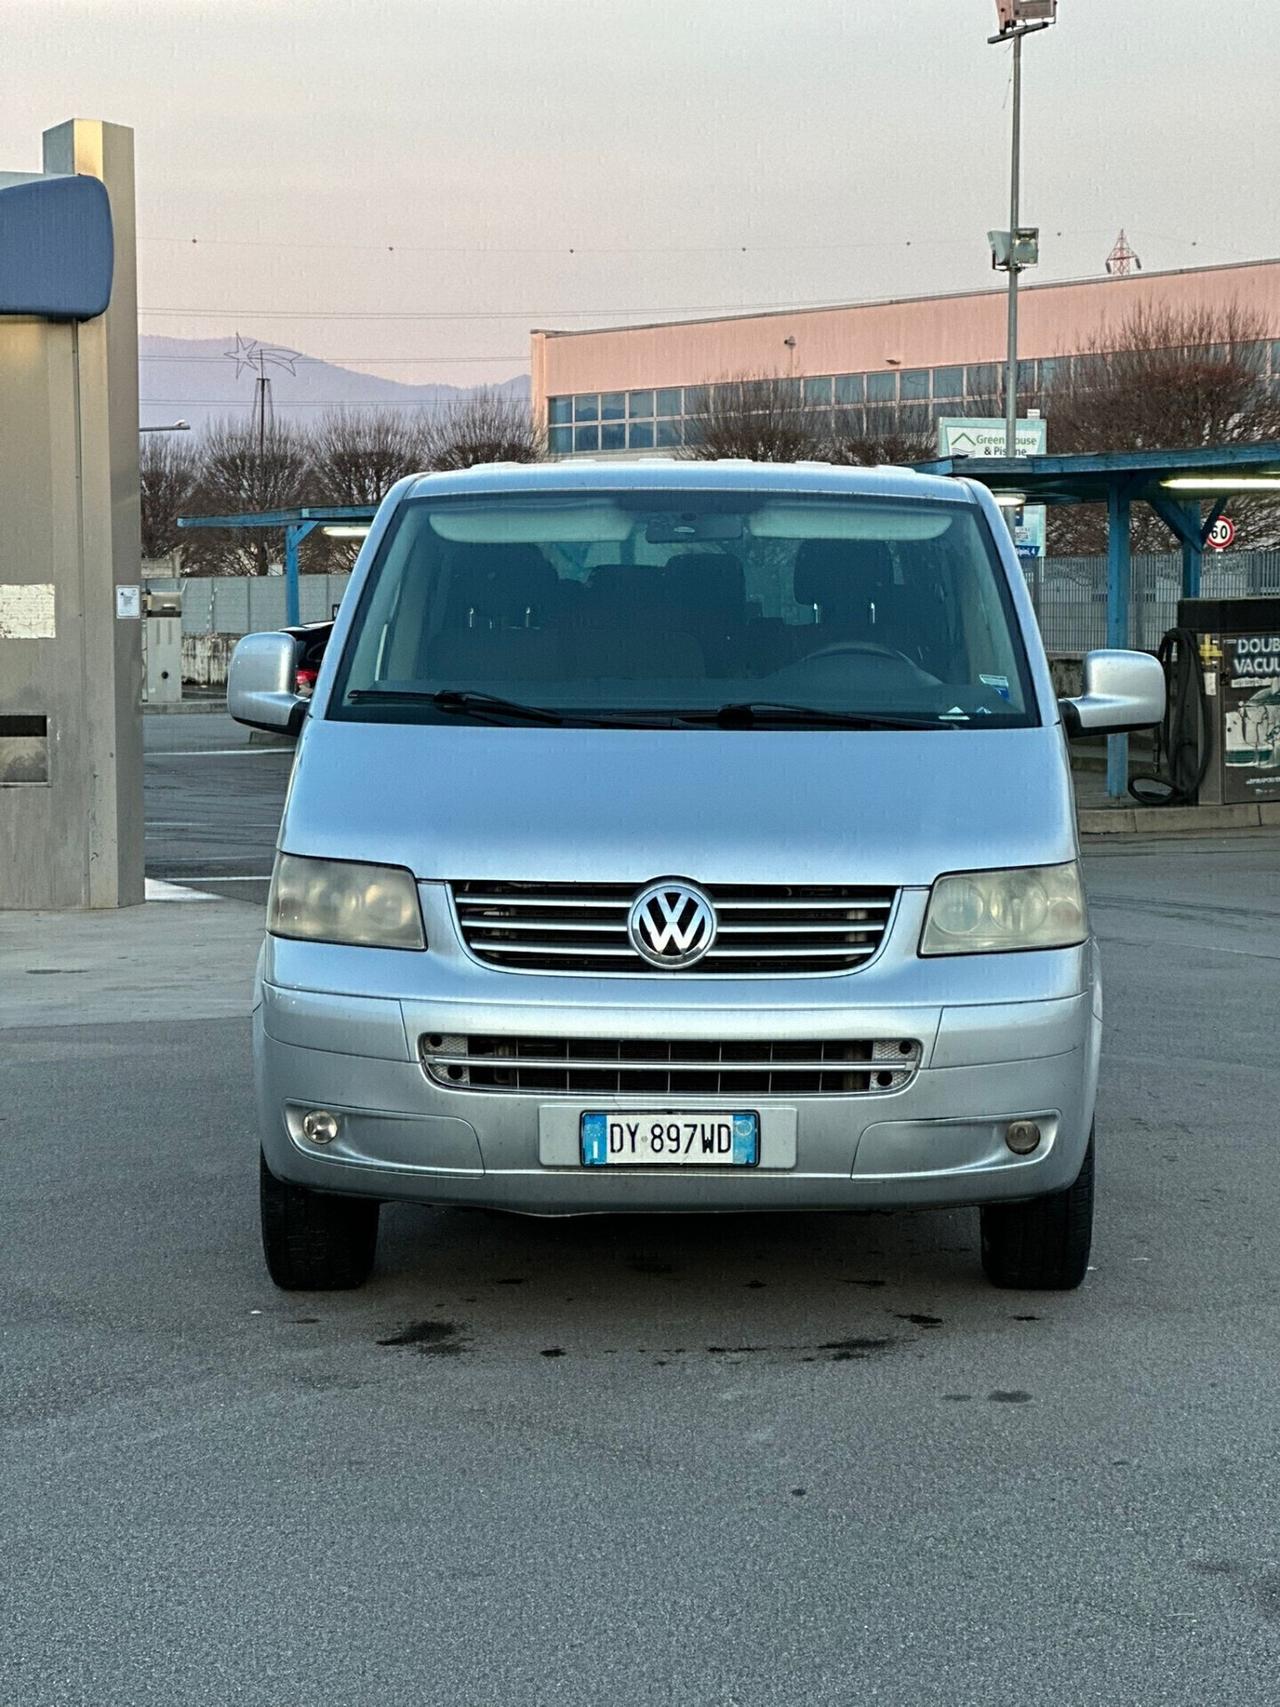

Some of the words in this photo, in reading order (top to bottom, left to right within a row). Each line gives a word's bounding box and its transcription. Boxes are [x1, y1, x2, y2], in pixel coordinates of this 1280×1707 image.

[976, 434, 1005, 445] Green
[984, 446, 991, 456] &
[994, 446, 1027, 457] Pisne
[1238, 637, 1280, 654] DOUB
[610, 1122, 640, 1153] DY
[650, 1123, 732, 1154] 897WD
